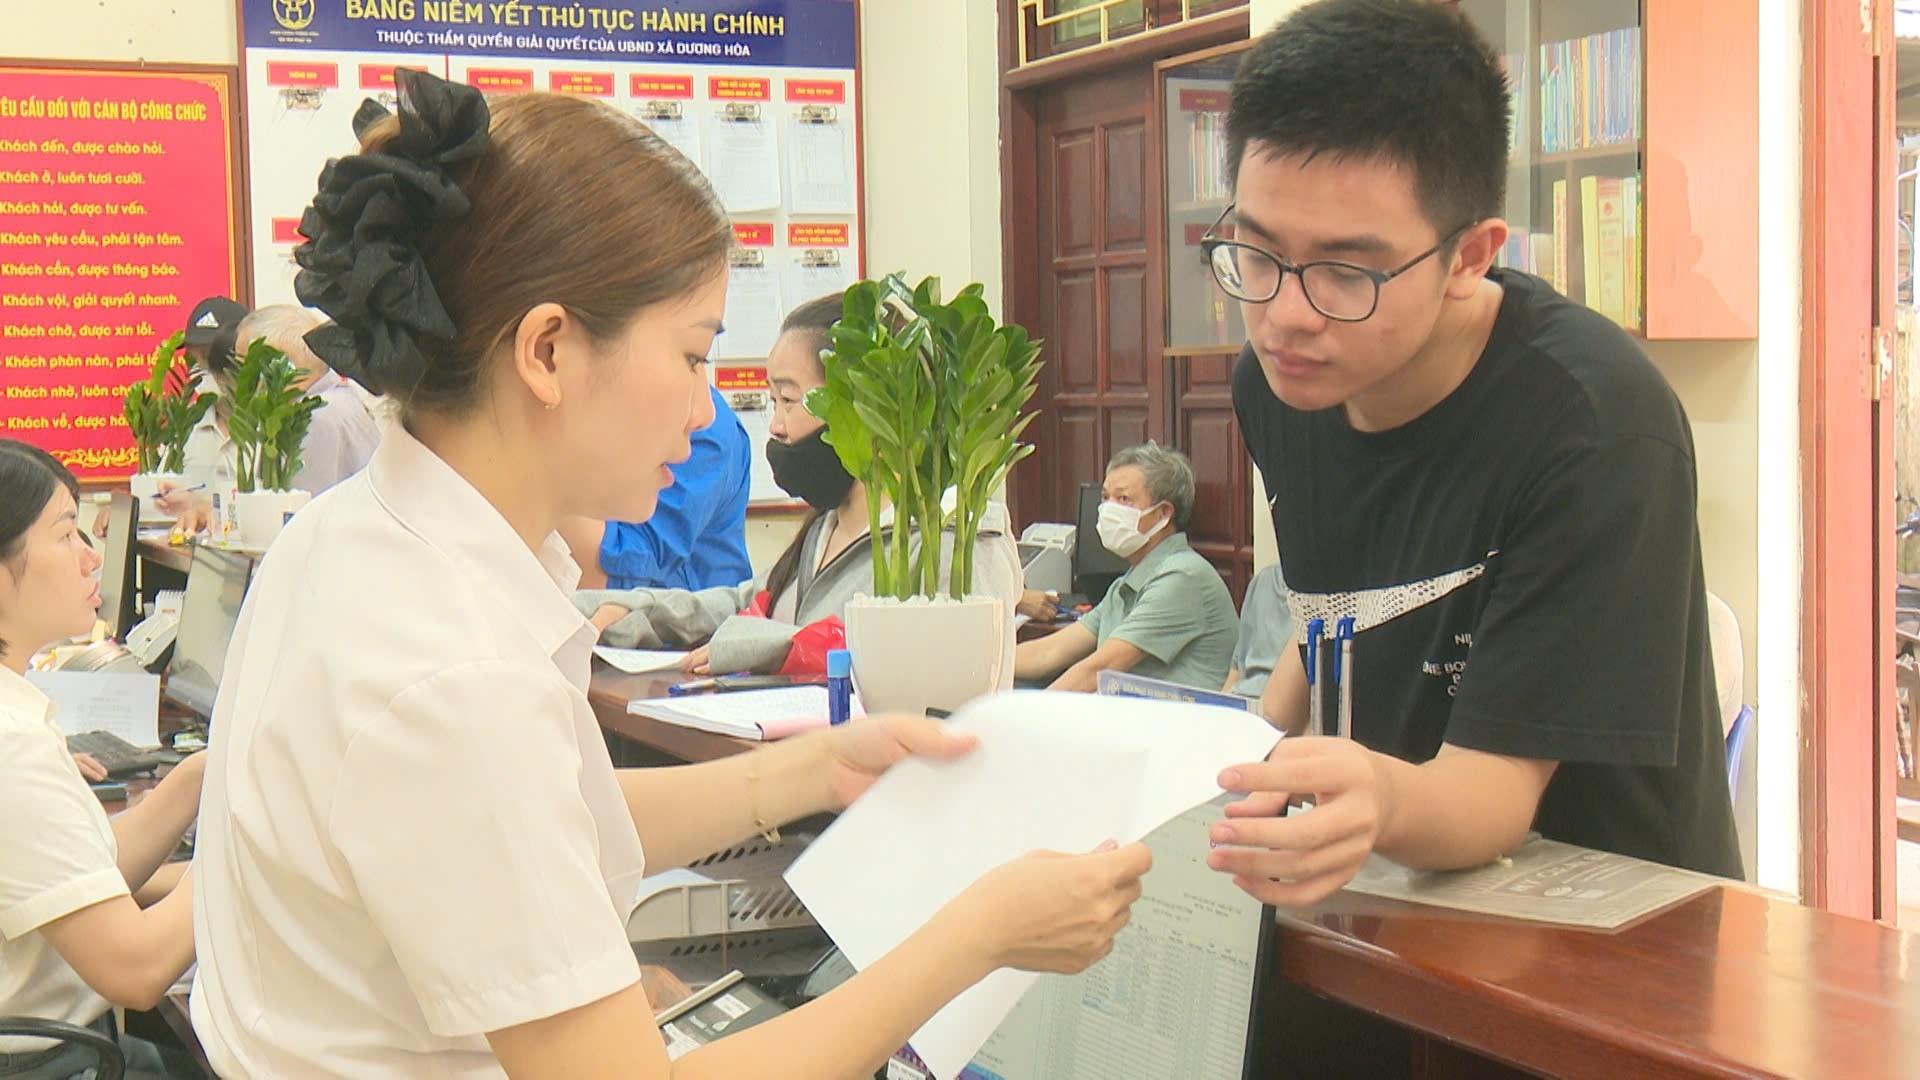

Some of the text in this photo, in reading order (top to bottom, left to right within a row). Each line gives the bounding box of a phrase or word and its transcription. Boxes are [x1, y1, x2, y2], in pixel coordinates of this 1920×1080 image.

[489, 0, 533, 26] YẾT
[537, 2, 585, 28] THỦ
[588, 9, 634, 34] TỤC
[641, 7, 706, 33] HÀNH
[713, 11, 785, 36] CHÍNH
[376, 28, 424, 46] THUỘC
[467, 31, 513, 48] QUYỀN
[516, 33, 543, 49] GIẢI
[617, 40, 654, 53] UBND
[657, 40, 674, 54] XÃ
[676, 41, 721, 56] DƯƠNG
[724, 42, 751, 57] HÒA
[0, 95, 17, 117] ÊU
[71, 96, 91, 119] VỚI
[94, 98, 118, 119] CÁN
[121, 99, 138, 123] BỘ
[141, 98, 173, 120] CÔNG
[175, 99, 207, 121] CHỨC
[41, 138, 69, 155] đến,
[72, 141, 104, 156] được
[108, 141, 140, 154] chào
[143, 141, 165, 154] hỏi.
[58, 171, 85, 184] luôn
[88, 172, 112, 184] tươi
[0, 200, 147, 217] Khách hỏi, được tư vấn.
[0, 229, 184, 248] Khách yêu cầu, phải tận tâm.
[2, 260, 180, 278] Khách cần, được thông báo.
[3, 291, 181, 309] Khách vội, giải quyết nhanh.
[4, 321, 155, 339] Khách chờ, được xin lỗi.
[5, 354, 46, 368] Khách
[50, 354, 82, 369] phàn
[86, 354, 113, 368] nàn,
[117, 352, 144, 368] phải
[7, 385, 47, 399] Khách
[51, 384, 78, 399] nhờ,
[82, 384, 108, 397] luôn
[112, 385, 131, 397] ch
[8, 416, 49, 429] Khách
[53, 413, 71, 429] về,
[75, 415, 106, 430] được
